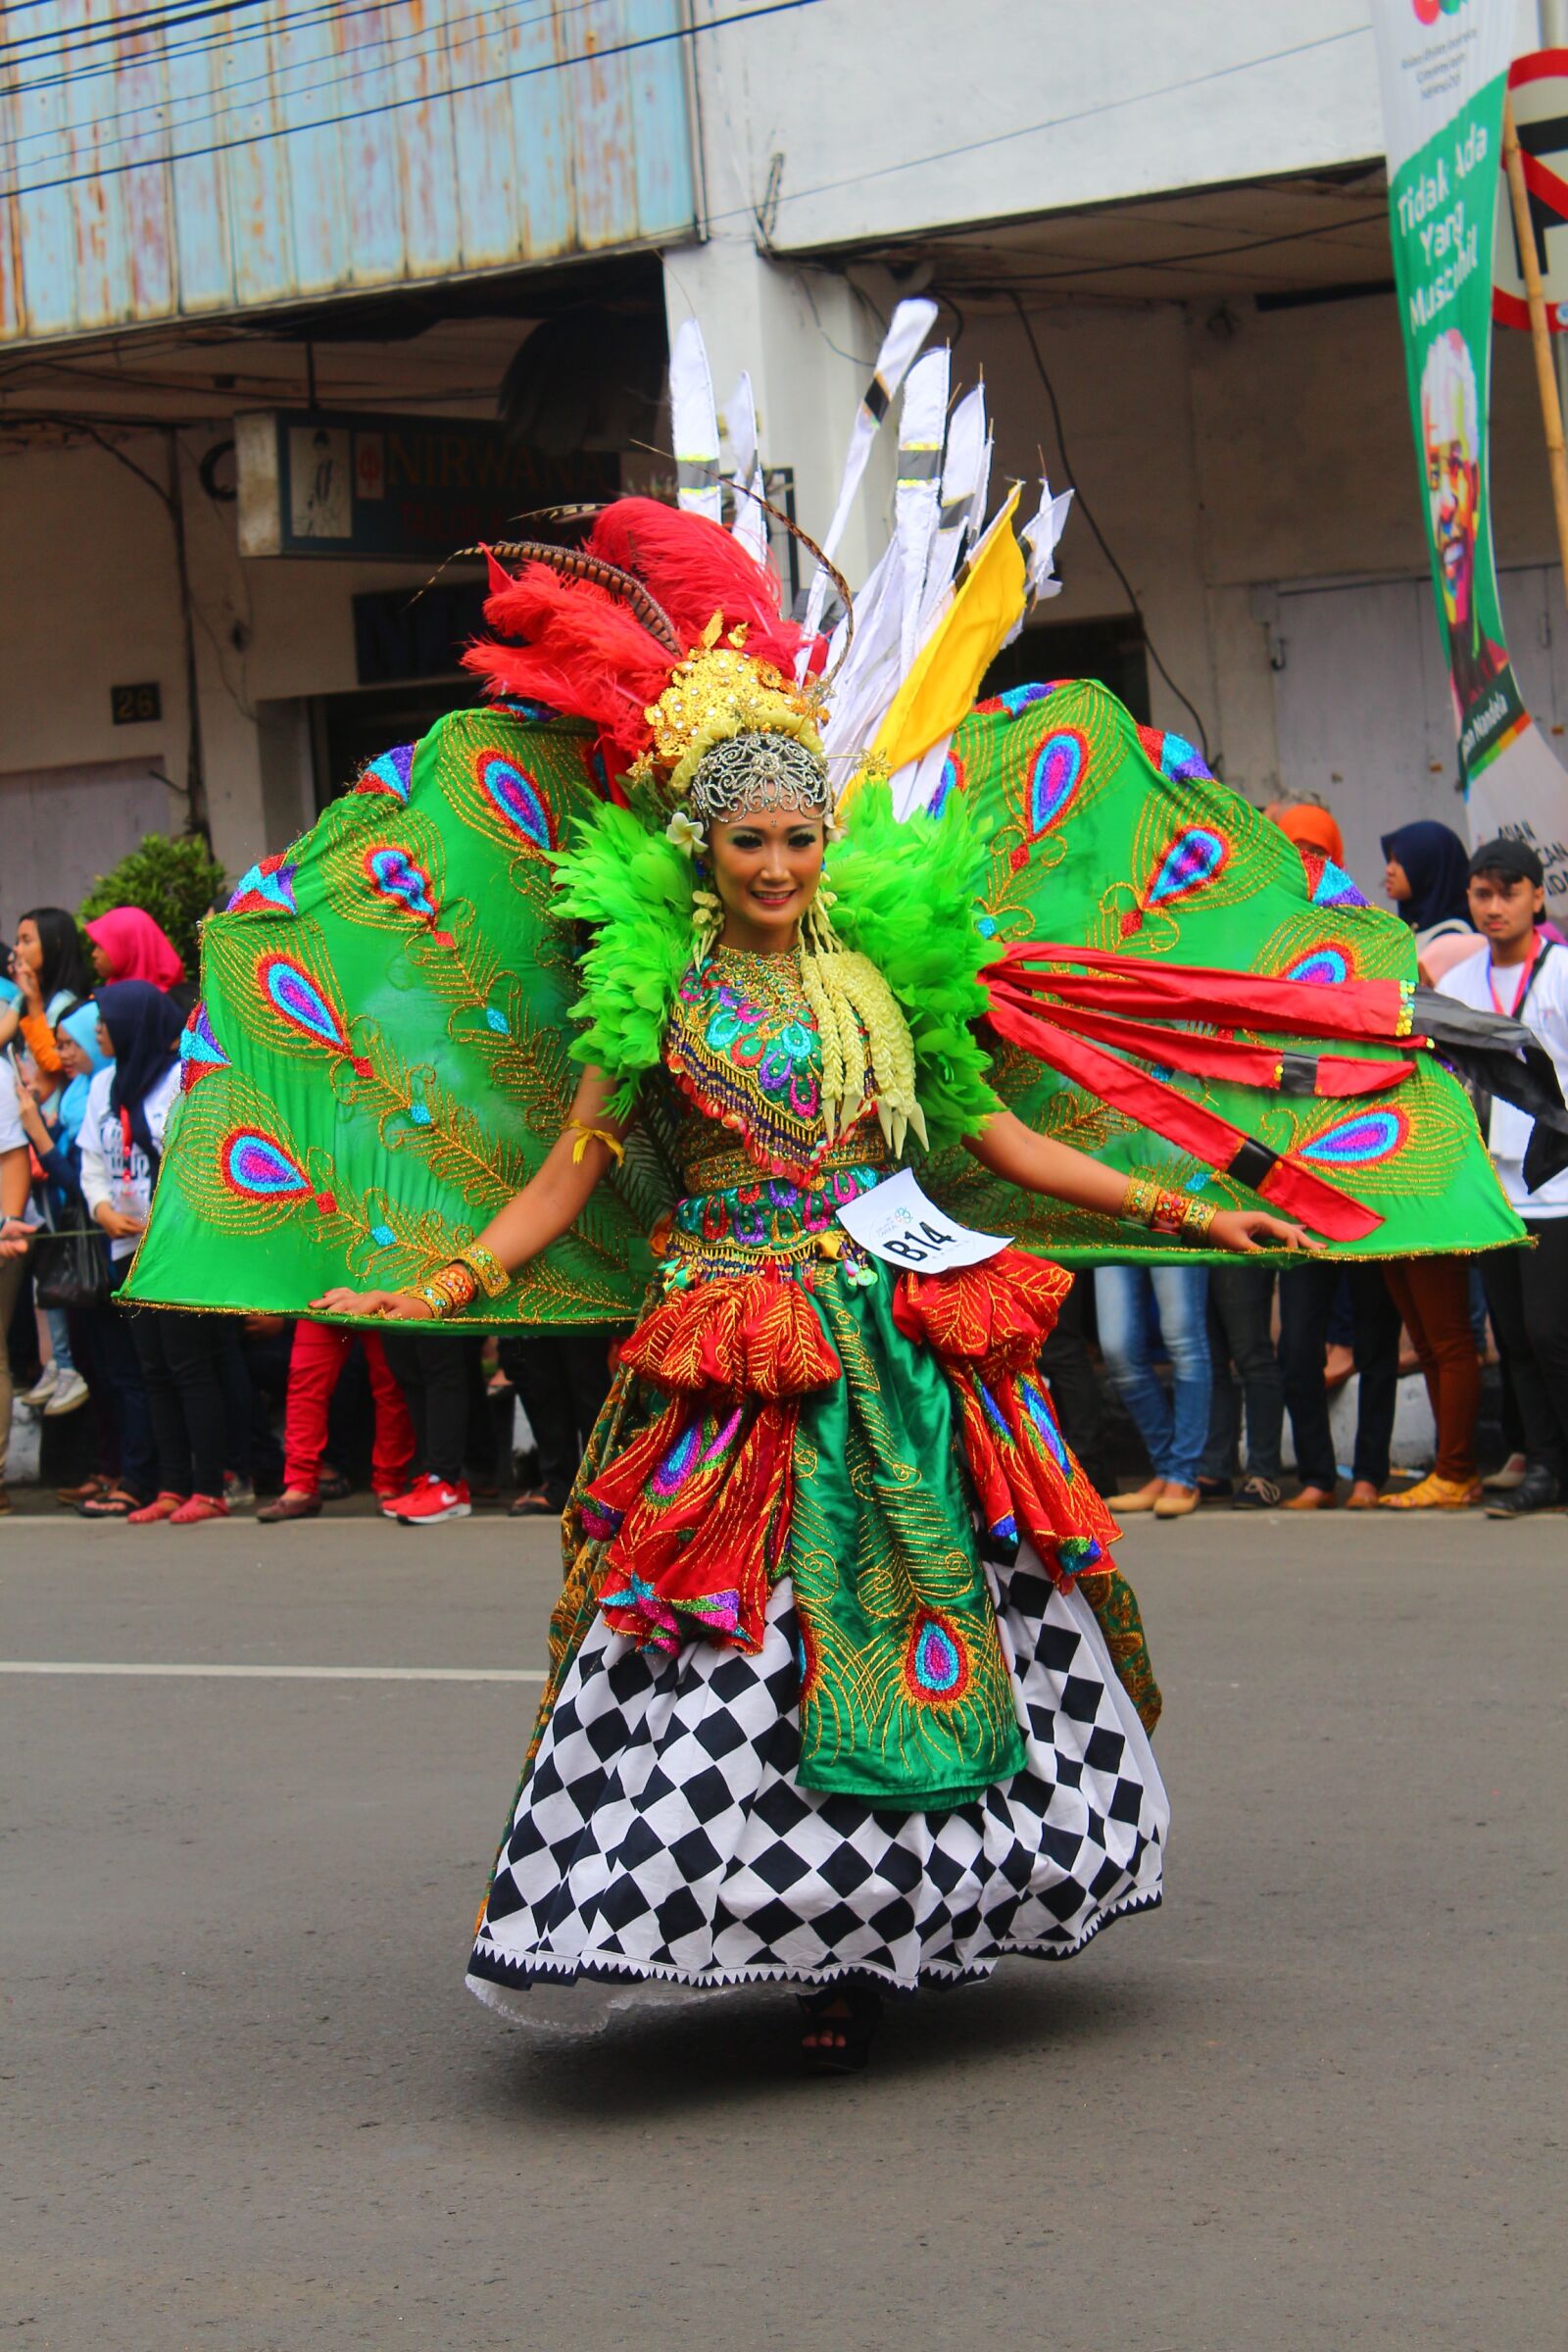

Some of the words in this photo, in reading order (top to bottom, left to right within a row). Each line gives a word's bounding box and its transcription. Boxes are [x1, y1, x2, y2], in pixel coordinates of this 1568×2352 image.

[1397, 157, 1449, 237] Tidak
[1455, 122, 1488, 178] Ada
[1419, 201, 1463, 267] Yang
[385, 432, 614, 498] NIRWANA
[883, 1221, 957, 1262] B14
